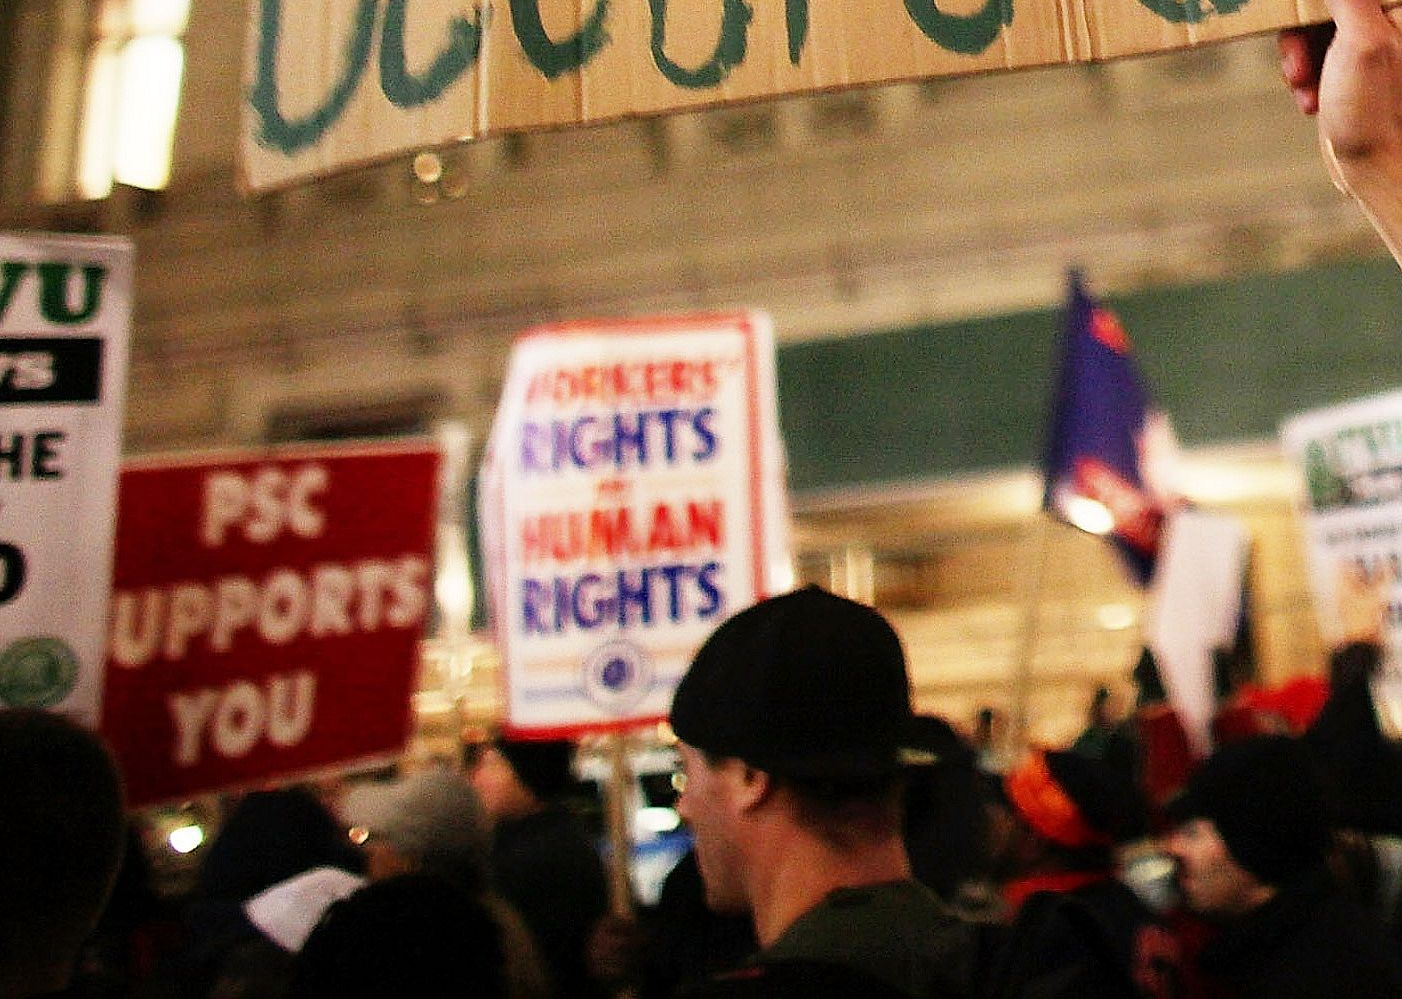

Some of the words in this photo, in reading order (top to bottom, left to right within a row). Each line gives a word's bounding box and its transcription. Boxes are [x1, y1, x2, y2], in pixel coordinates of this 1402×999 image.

[519, 406, 719, 474] RIGHTS
[200, 463, 331, 548] PSC
[521, 497, 725, 562] HUMAN
[111, 555, 432, 669] UPPORTS
[521, 560, 725, 637] RIGHTS
[167, 668, 318, 768] YOU
